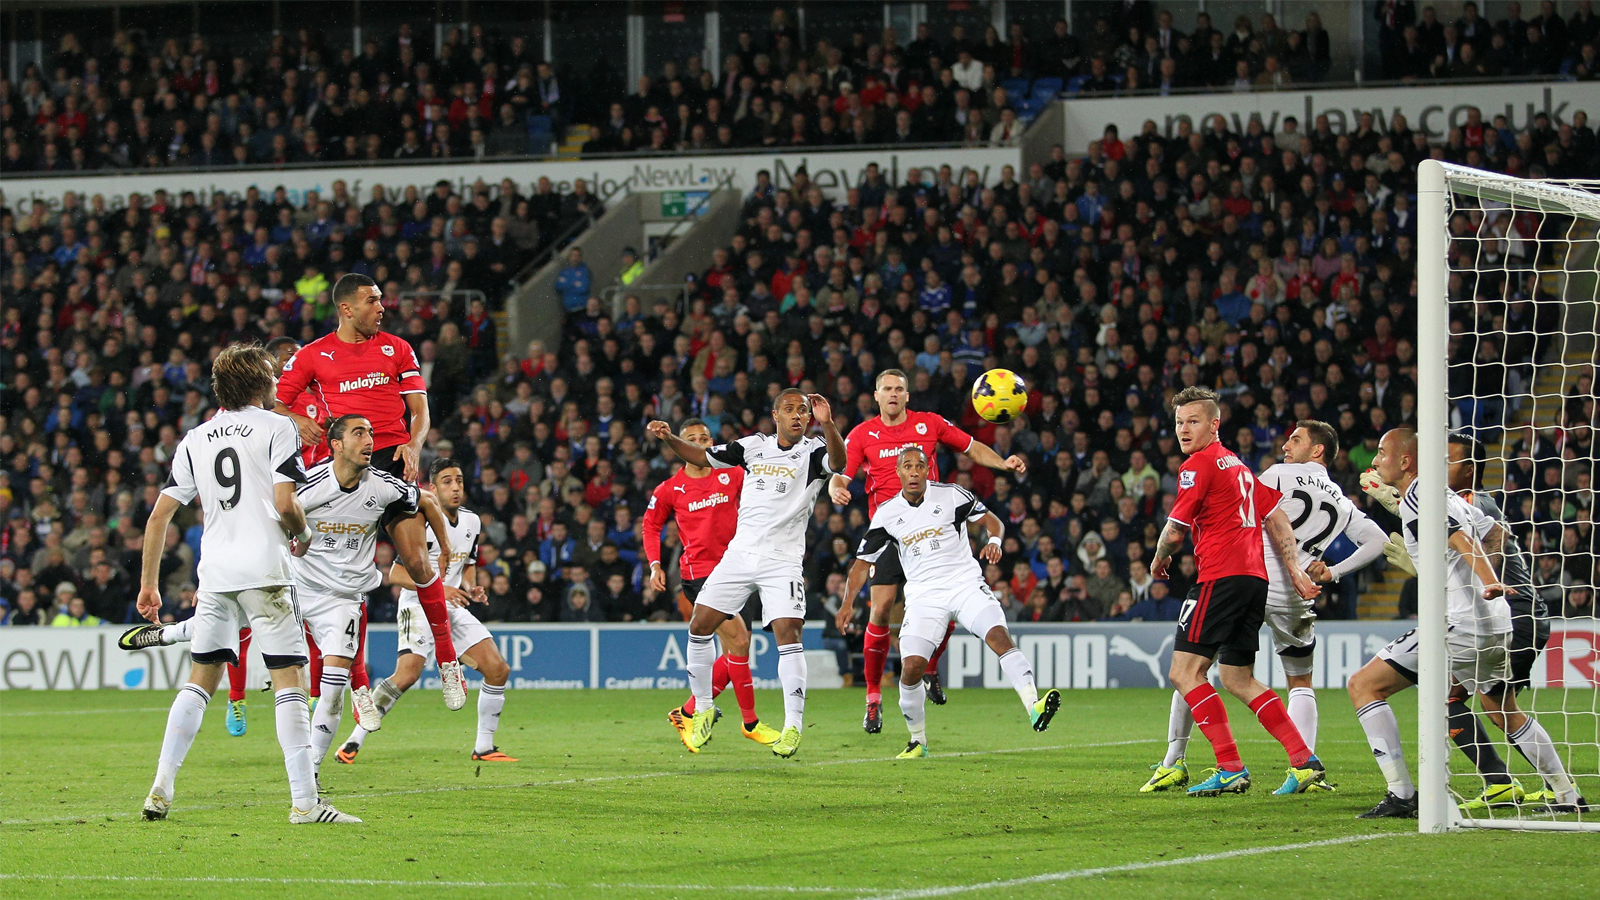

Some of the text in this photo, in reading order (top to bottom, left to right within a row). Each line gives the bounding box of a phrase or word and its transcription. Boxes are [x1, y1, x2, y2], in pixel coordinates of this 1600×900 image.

[633, 163, 736, 188] NewLaw
[339, 372, 390, 393] Malaysia
[207, 424, 254, 443] MICHU
[214, 446, 242, 511] 9
[1237, 471, 1256, 528] 17
[1295, 475, 1342, 505] RANGEL
[688, 493, 729, 513] Malaysia
[1291, 489, 1339, 557] 22
[789, 581, 805, 601] 15
[345, 618, 356, 639] 4
[947, 634, 1108, 689] PUMA
[515, 678, 584, 690] Designers
[605, 677, 687, 690] Cardiff City
